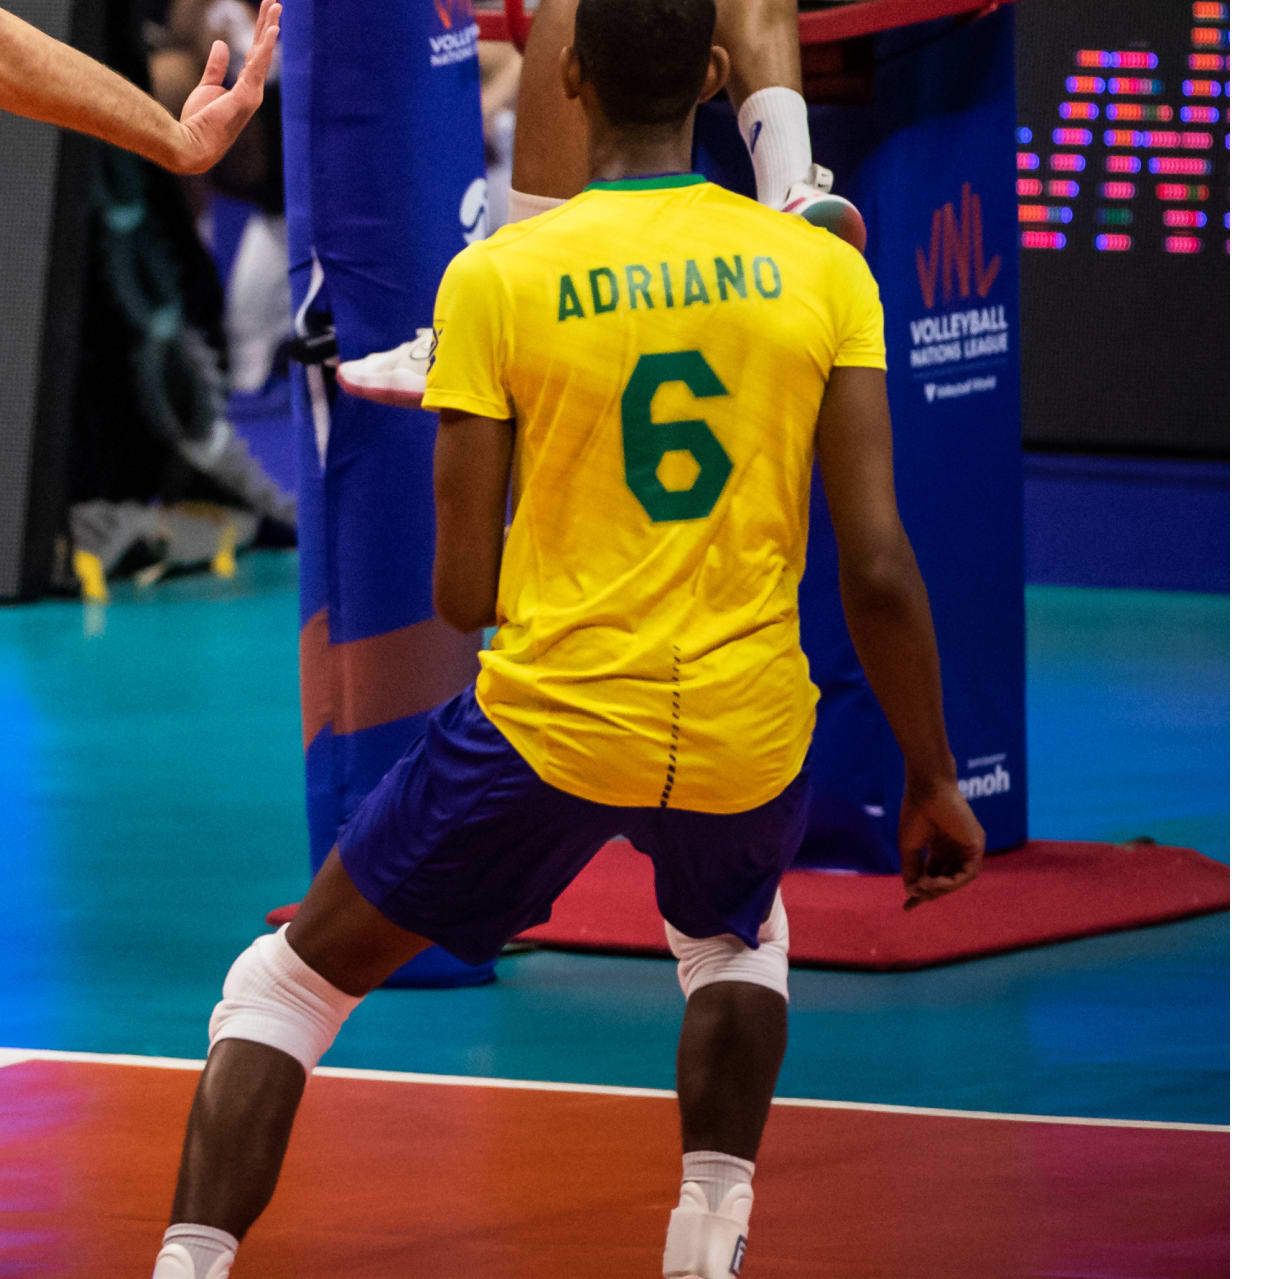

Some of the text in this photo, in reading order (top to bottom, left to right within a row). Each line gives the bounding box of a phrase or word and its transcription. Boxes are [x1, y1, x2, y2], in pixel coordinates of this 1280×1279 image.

[557, 255, 782, 323] ADRIANO
[910, 305, 1008, 346] VOLLEYBALL
[910, 332, 1008, 368] NATIONS LEAGUE
[620, 350, 735, 523] 6
